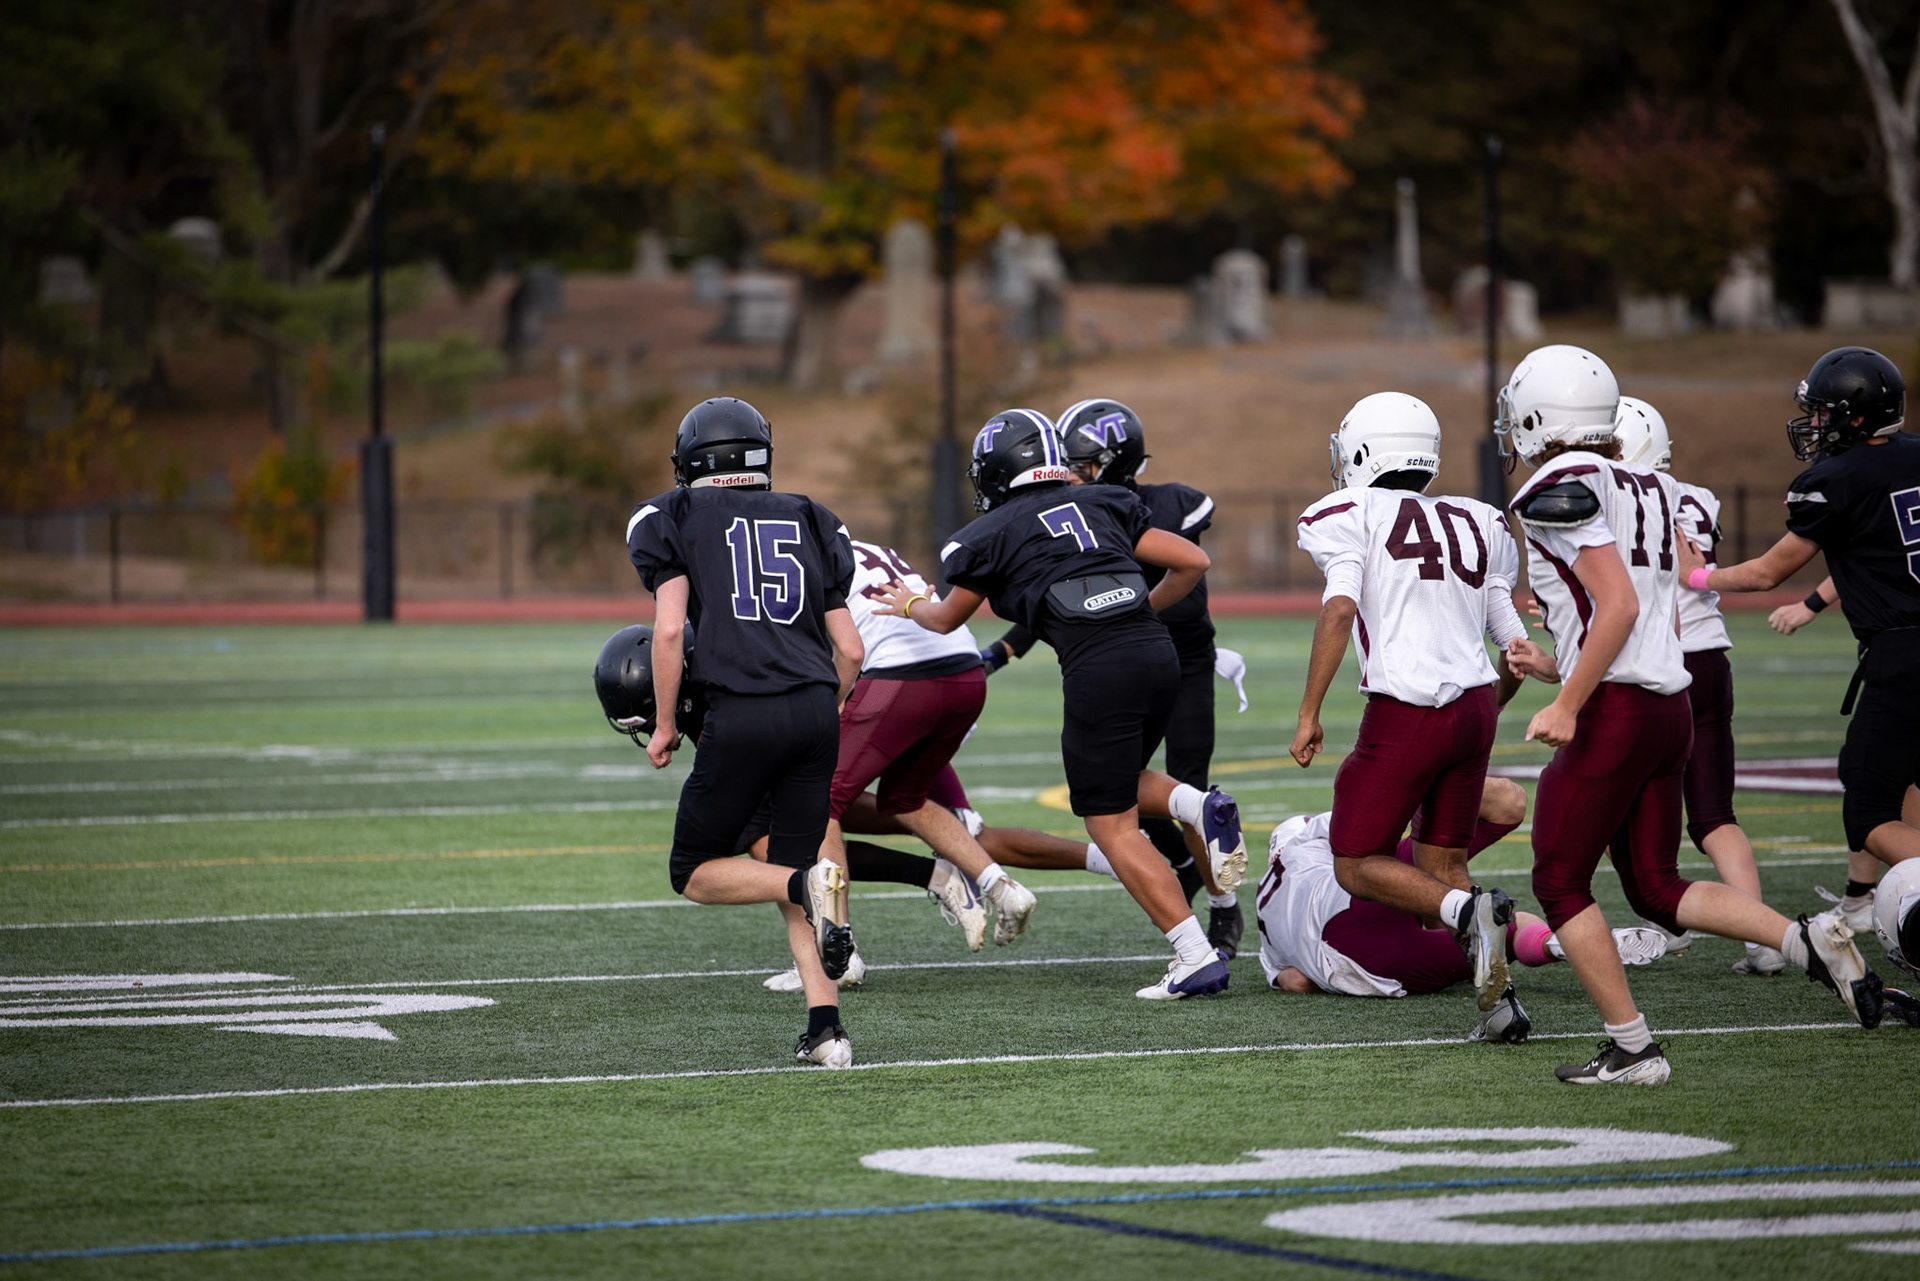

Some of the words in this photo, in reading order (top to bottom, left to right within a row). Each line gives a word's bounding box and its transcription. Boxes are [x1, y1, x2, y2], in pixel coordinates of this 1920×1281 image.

[1078, 412, 1128, 449] VT
[712, 476, 755, 486] Riddell
[1406, 457, 1436, 468] schutt
[1037, 501, 1099, 553] 7
[1608, 464, 1673, 572] 77
[1385, 498, 1488, 590] 40
[725, 516, 804, 625] 15
[1088, 590, 1132, 608] BATTLE
